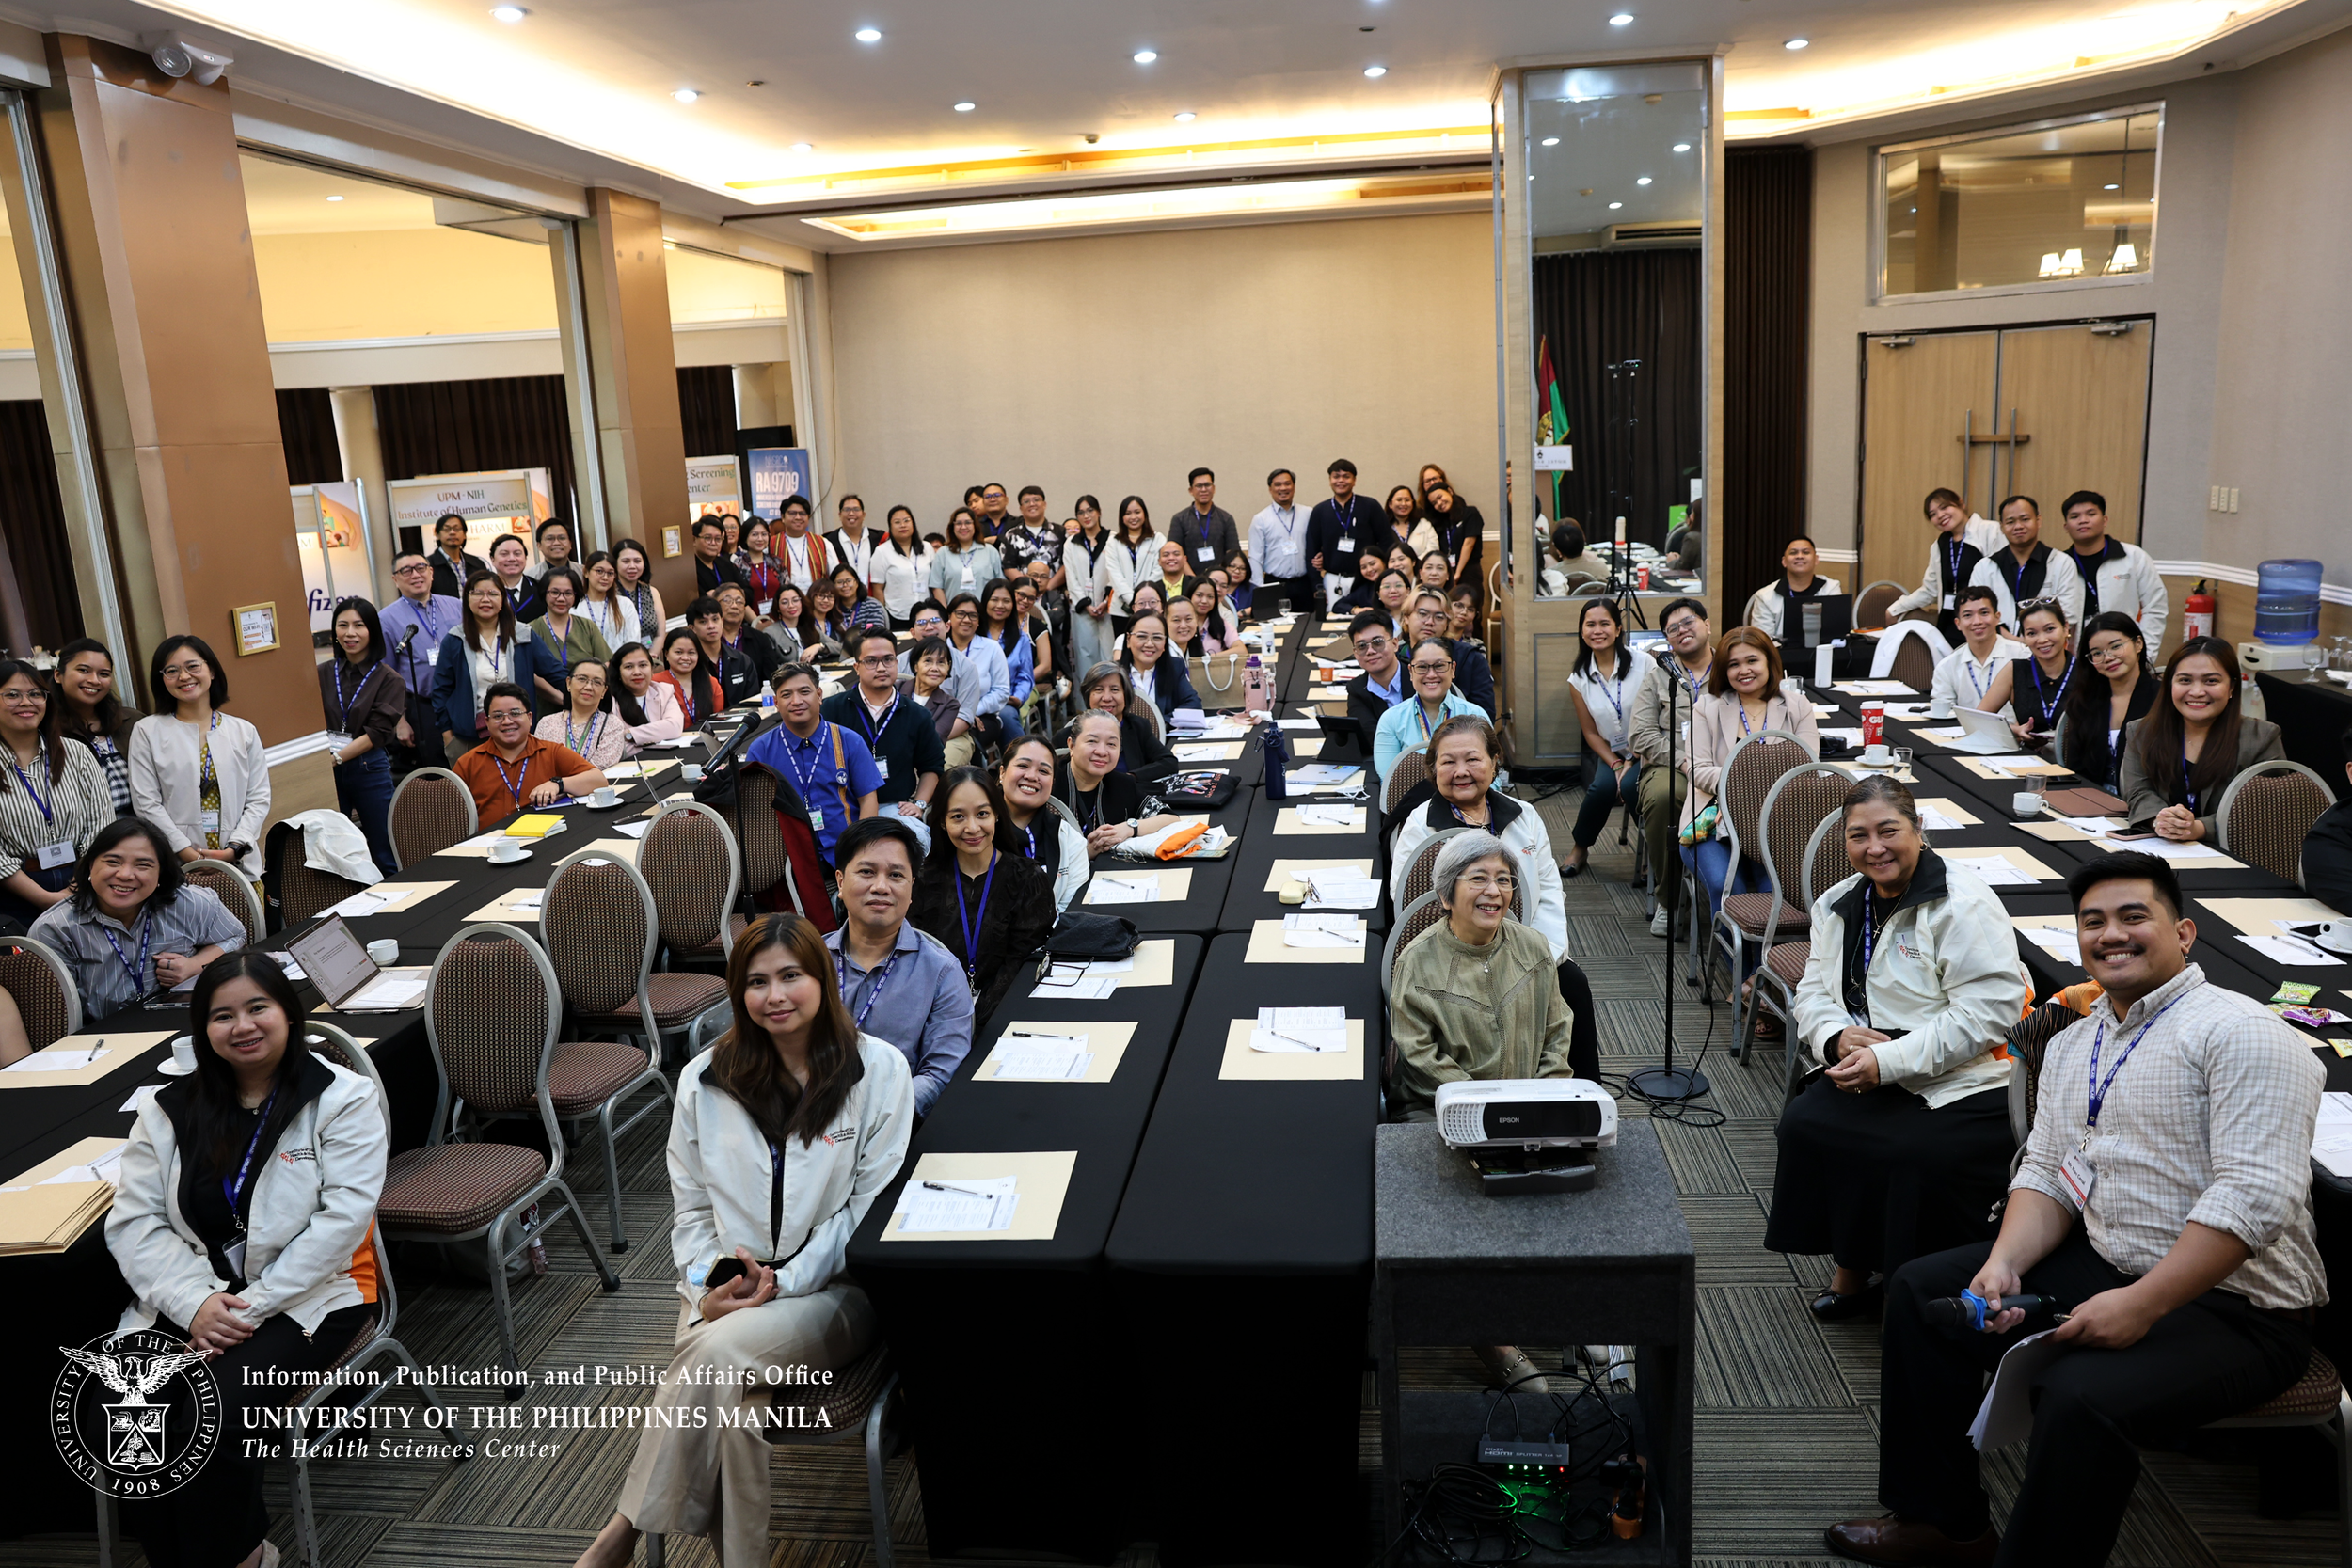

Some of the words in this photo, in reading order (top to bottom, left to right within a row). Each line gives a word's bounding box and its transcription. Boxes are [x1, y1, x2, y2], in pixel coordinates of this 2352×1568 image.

[690, 467, 735, 479] Screening
[756, 472, 772, 492] RA
[772, 471, 799, 492] 9709
[688, 483, 711, 493] enter
[437, 491, 461, 502] UPM
[466, 490, 485, 499] NIH
[398, 509, 438, 520] Institute
[440, 506, 452, 516] of
[452, 506, 486, 516] Human
[487, 502, 528, 512] Genetics
